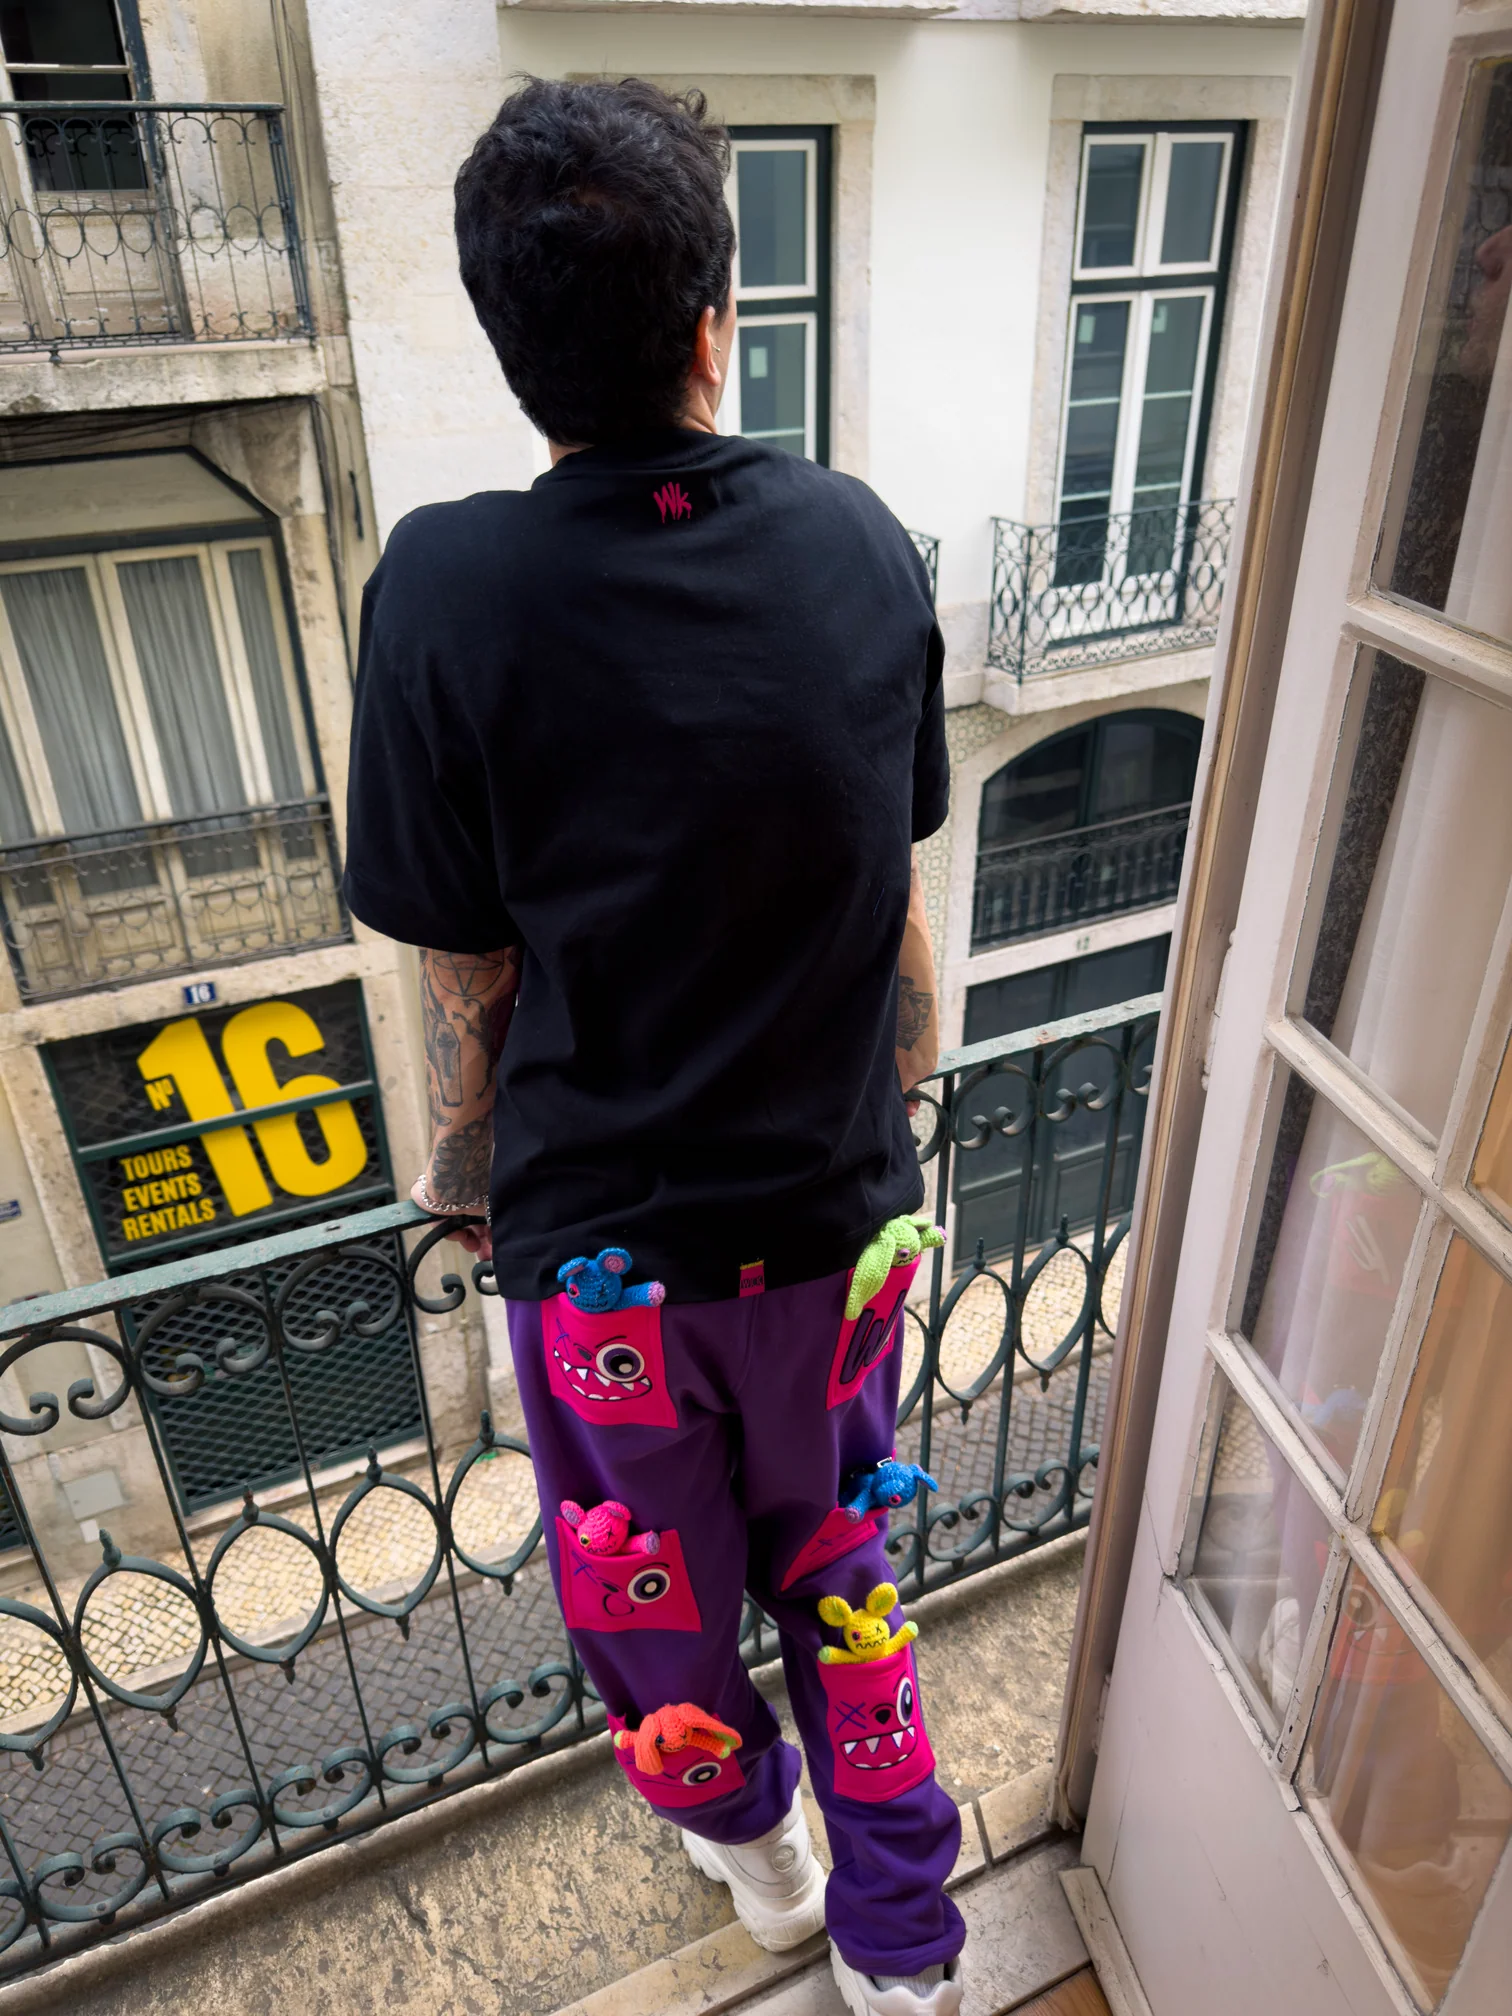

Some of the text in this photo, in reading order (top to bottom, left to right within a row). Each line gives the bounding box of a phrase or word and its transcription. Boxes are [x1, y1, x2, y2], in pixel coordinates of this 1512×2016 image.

[190, 984, 209, 1004] 16
[137, 1002, 368, 1217] 16
[120, 1145, 192, 1181] TOURS
[123, 1173, 203, 1212] EVENTS
[121, 1198, 216, 1241] RENTALS
